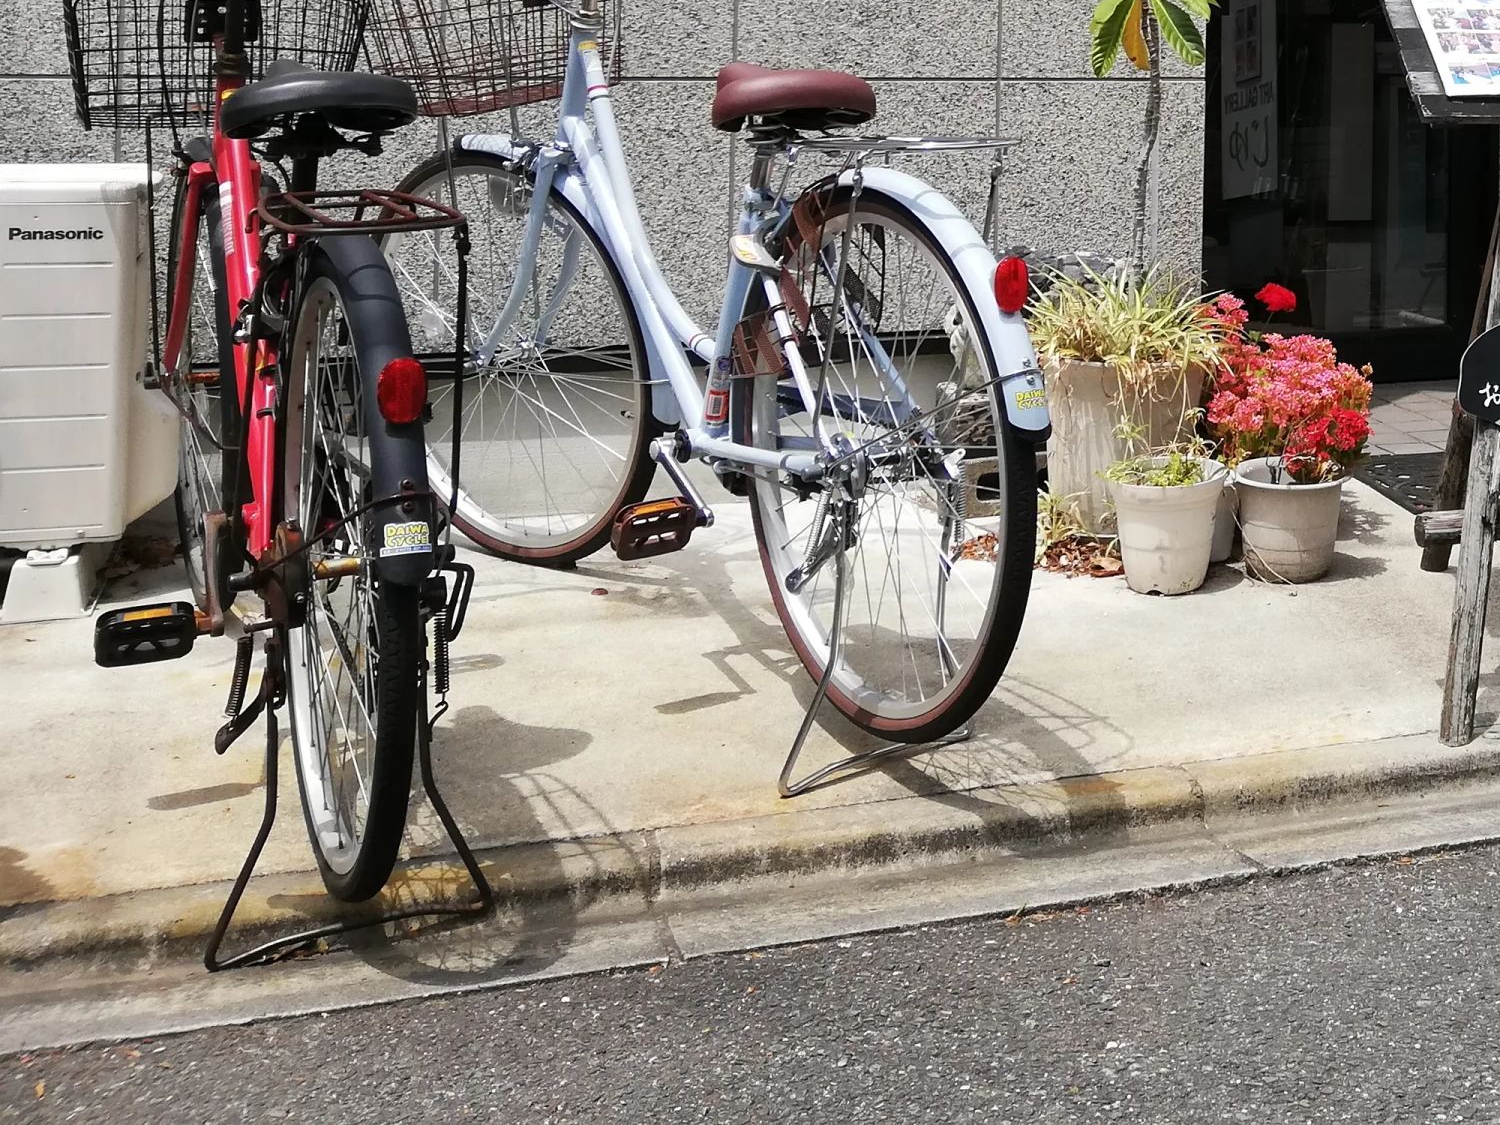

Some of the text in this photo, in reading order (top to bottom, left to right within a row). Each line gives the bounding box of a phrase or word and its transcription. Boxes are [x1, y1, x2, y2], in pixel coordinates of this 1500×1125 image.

[8, 227, 104, 241] Panasonic
[386, 524, 428, 538] DAIWA
[386, 535, 428, 547] CYCLE
